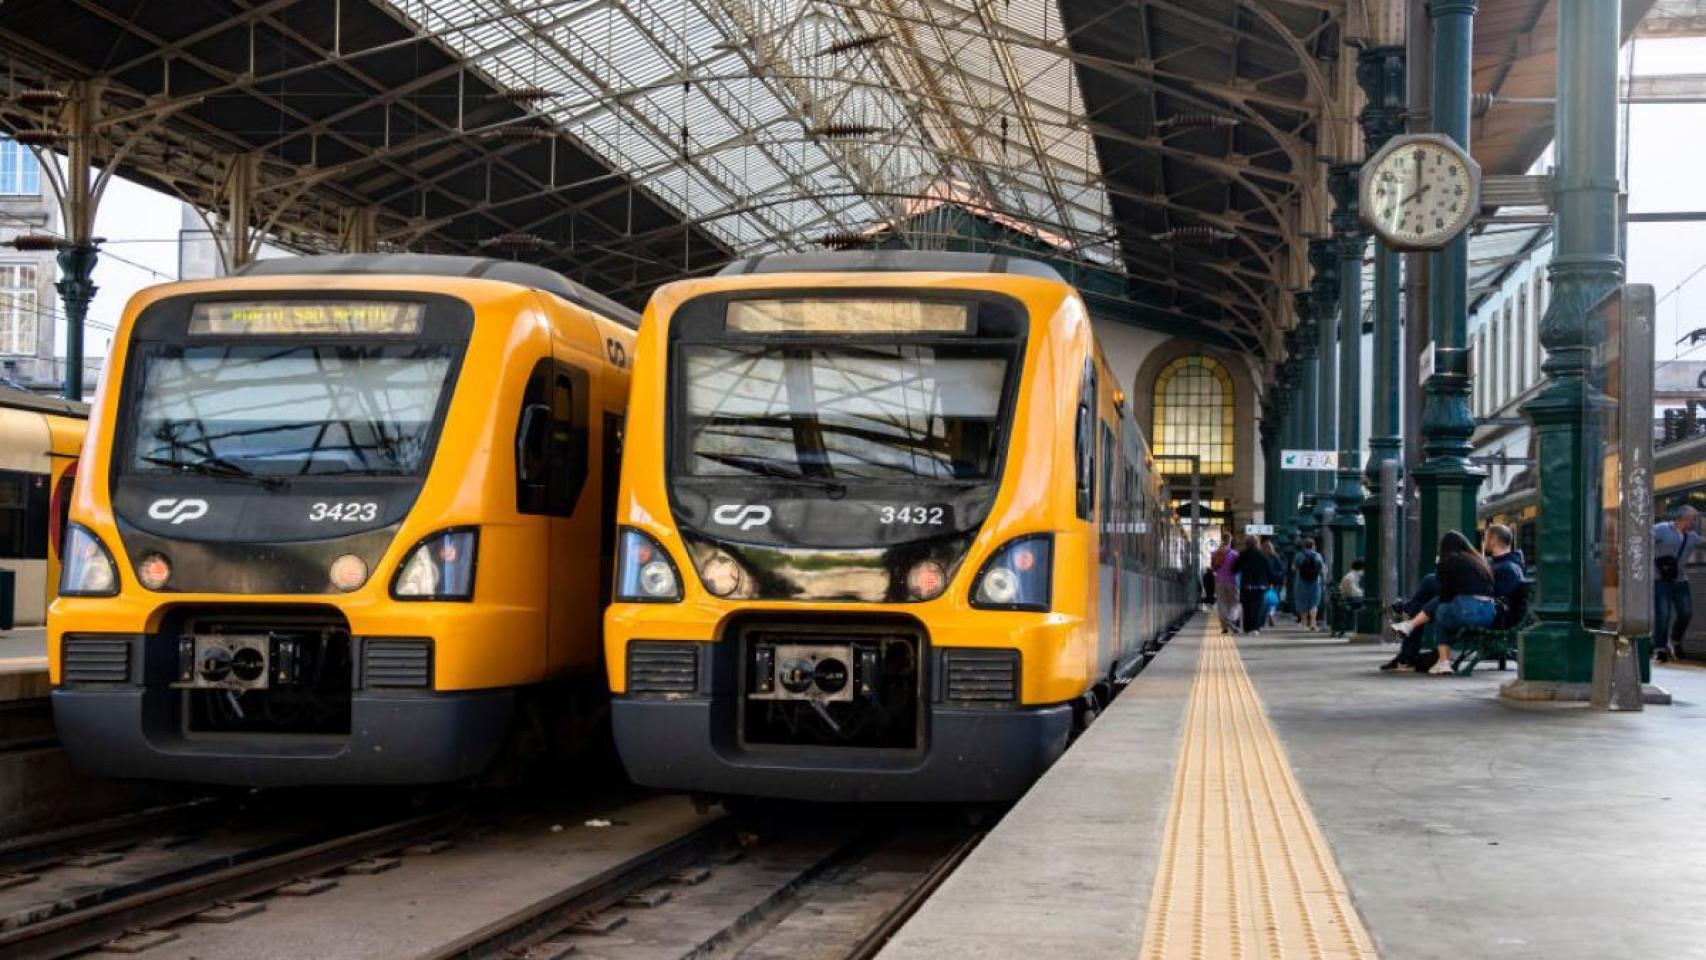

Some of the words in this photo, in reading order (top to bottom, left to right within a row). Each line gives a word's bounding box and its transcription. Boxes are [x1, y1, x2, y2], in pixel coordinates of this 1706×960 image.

[148, 499, 209, 524] CP
[309, 502, 378, 521] 3423
[713, 504, 772, 530] CP
[879, 506, 944, 525] 3432
